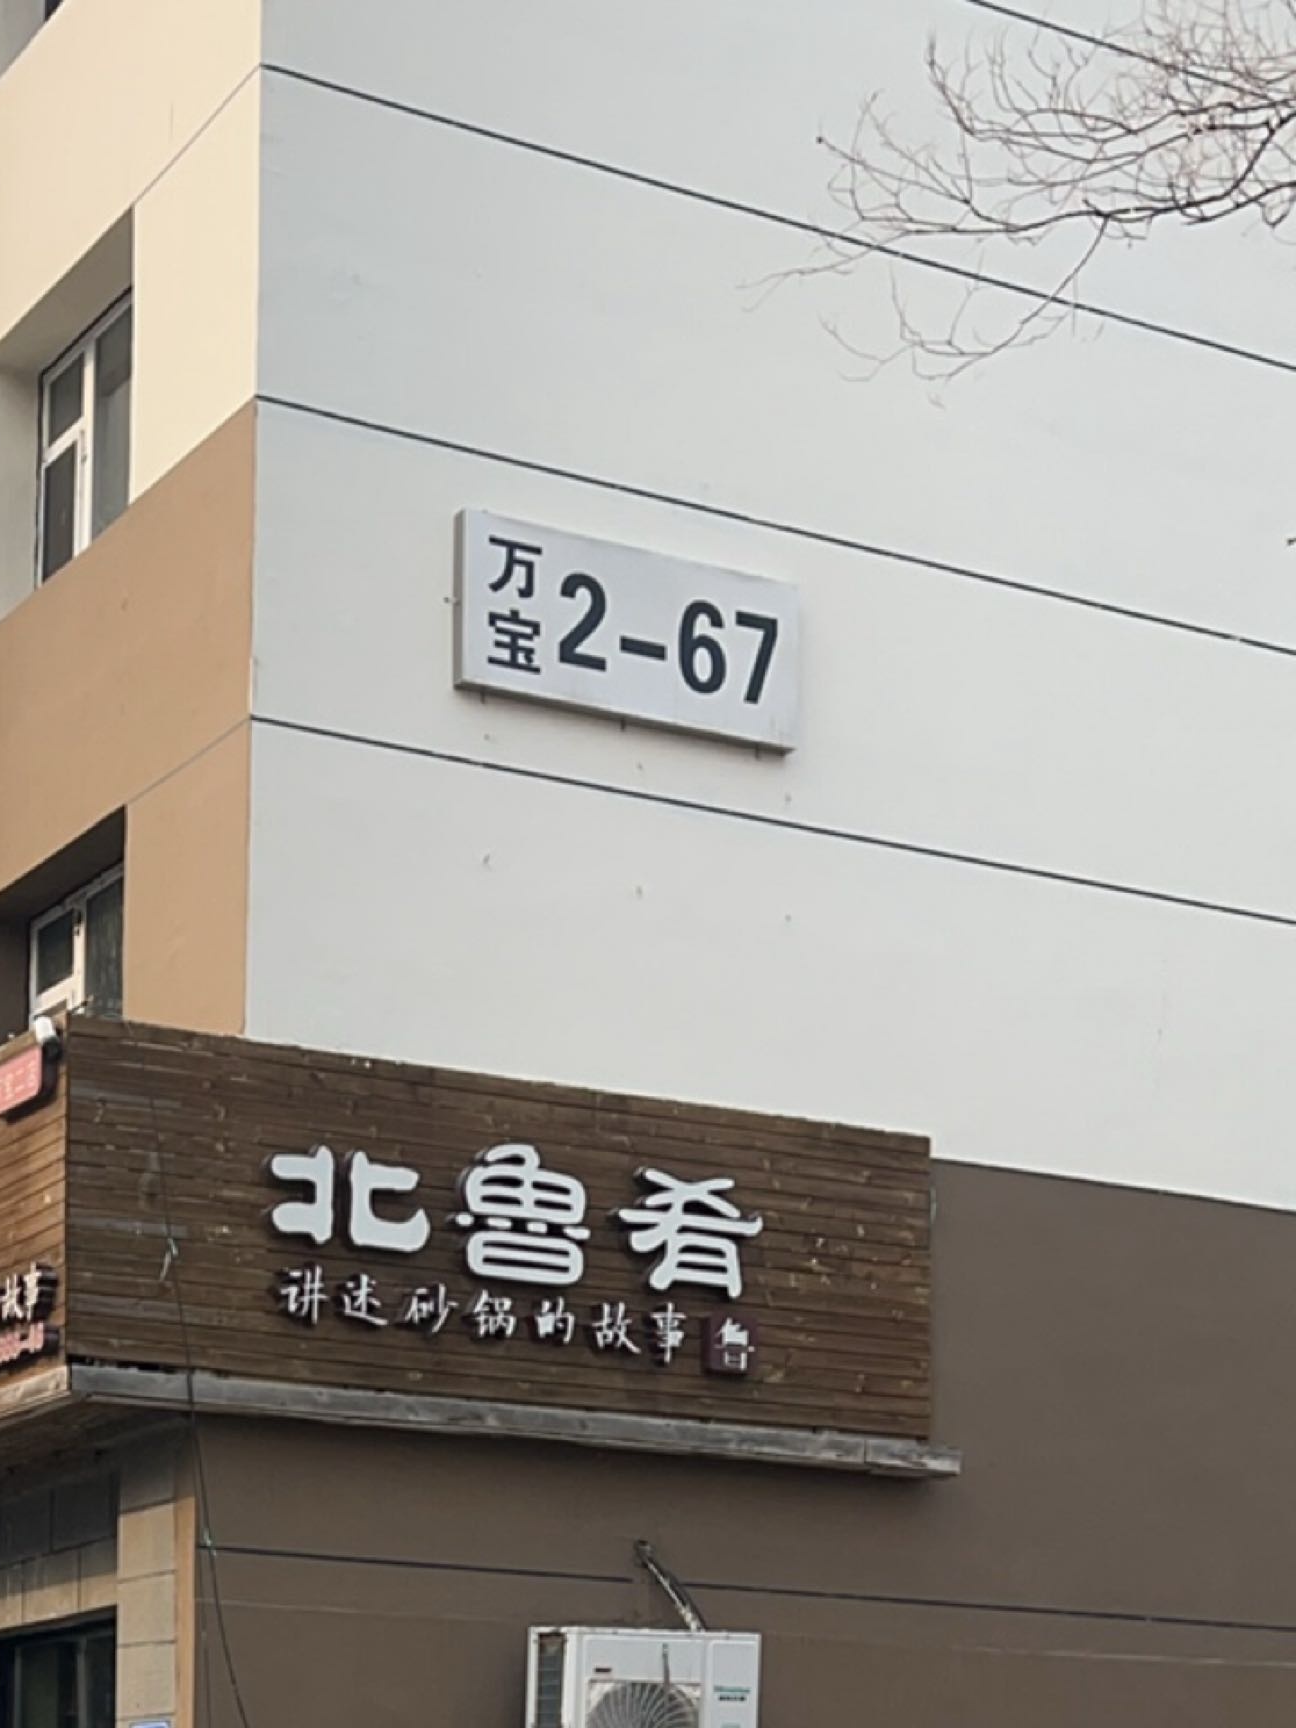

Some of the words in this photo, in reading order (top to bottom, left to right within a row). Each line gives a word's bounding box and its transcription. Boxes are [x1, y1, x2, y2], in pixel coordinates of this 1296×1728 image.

[487, 534, 543, 675] 万宝
[559, 572, 779, 705] 2-67
[271, 1144, 764, 1299] 北魯肴
[278, 1265, 687, 1365] 讲述砂锅的故事
